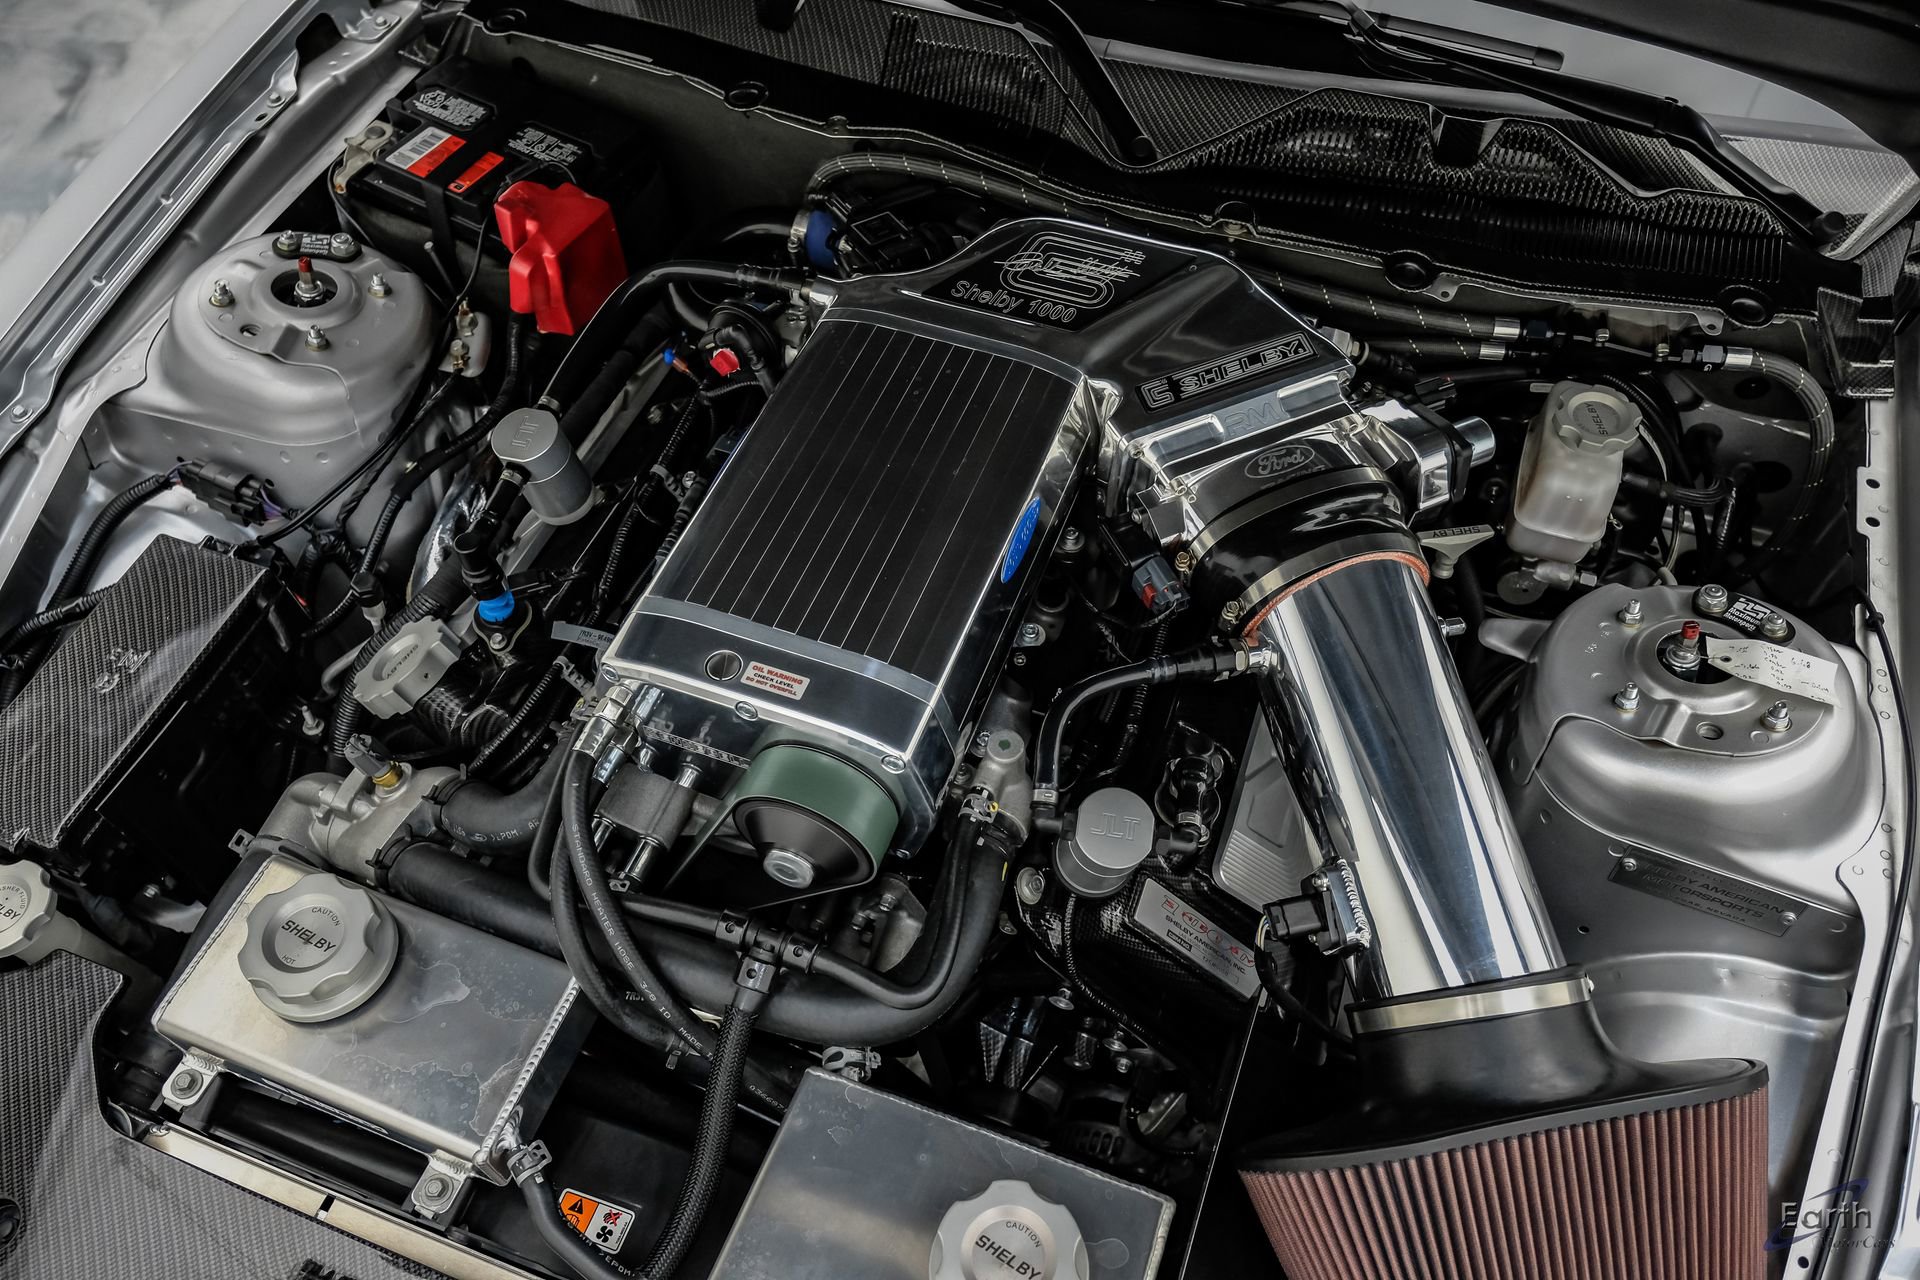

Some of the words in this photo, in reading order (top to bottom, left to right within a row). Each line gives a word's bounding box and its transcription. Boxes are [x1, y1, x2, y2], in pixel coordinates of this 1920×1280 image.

[950, 280, 1024, 314] Shelby
[1028, 299, 1077, 323] 1000
[1583, 402, 1608, 436] SHELBY
[1258, 448, 1305, 475] Ford
[1432, 526, 1480, 538] SHELBY
[1723, 612, 1757, 632] Motorsports
[1727, 607, 1760, 626] Maximum
[752, 664, 765, 674] OIL
[766, 668, 804, 686] WARNING
[753, 672, 775, 683] CHECK
[775, 678, 794, 689] LEVEL
[755, 678, 768, 688] NOT
[769, 683, 798, 697] OVERFILL
[1089, 811, 1142, 841] JLT
[1642, 873, 1764, 918] MOTORSPORTS
[1699, 882, 1786, 914] AMERICAN
[311, 906, 341, 926] CAUTION
[1165, 914, 1193, 937] SHELBY
[281, 919, 337, 953] SHELBY
[571, 823, 593, 887] STANDARD
[591, 891, 616, 937] HEATER
[614, 941, 636, 971] HOSE
[639, 980, 657, 1002] 3/8
[678, 1026, 703, 1050] MADE
[281, 954, 297, 965] HOT
[1005, 1220, 1042, 1248] CAUTION
[975, 1234, 1042, 1280] SHELBY
